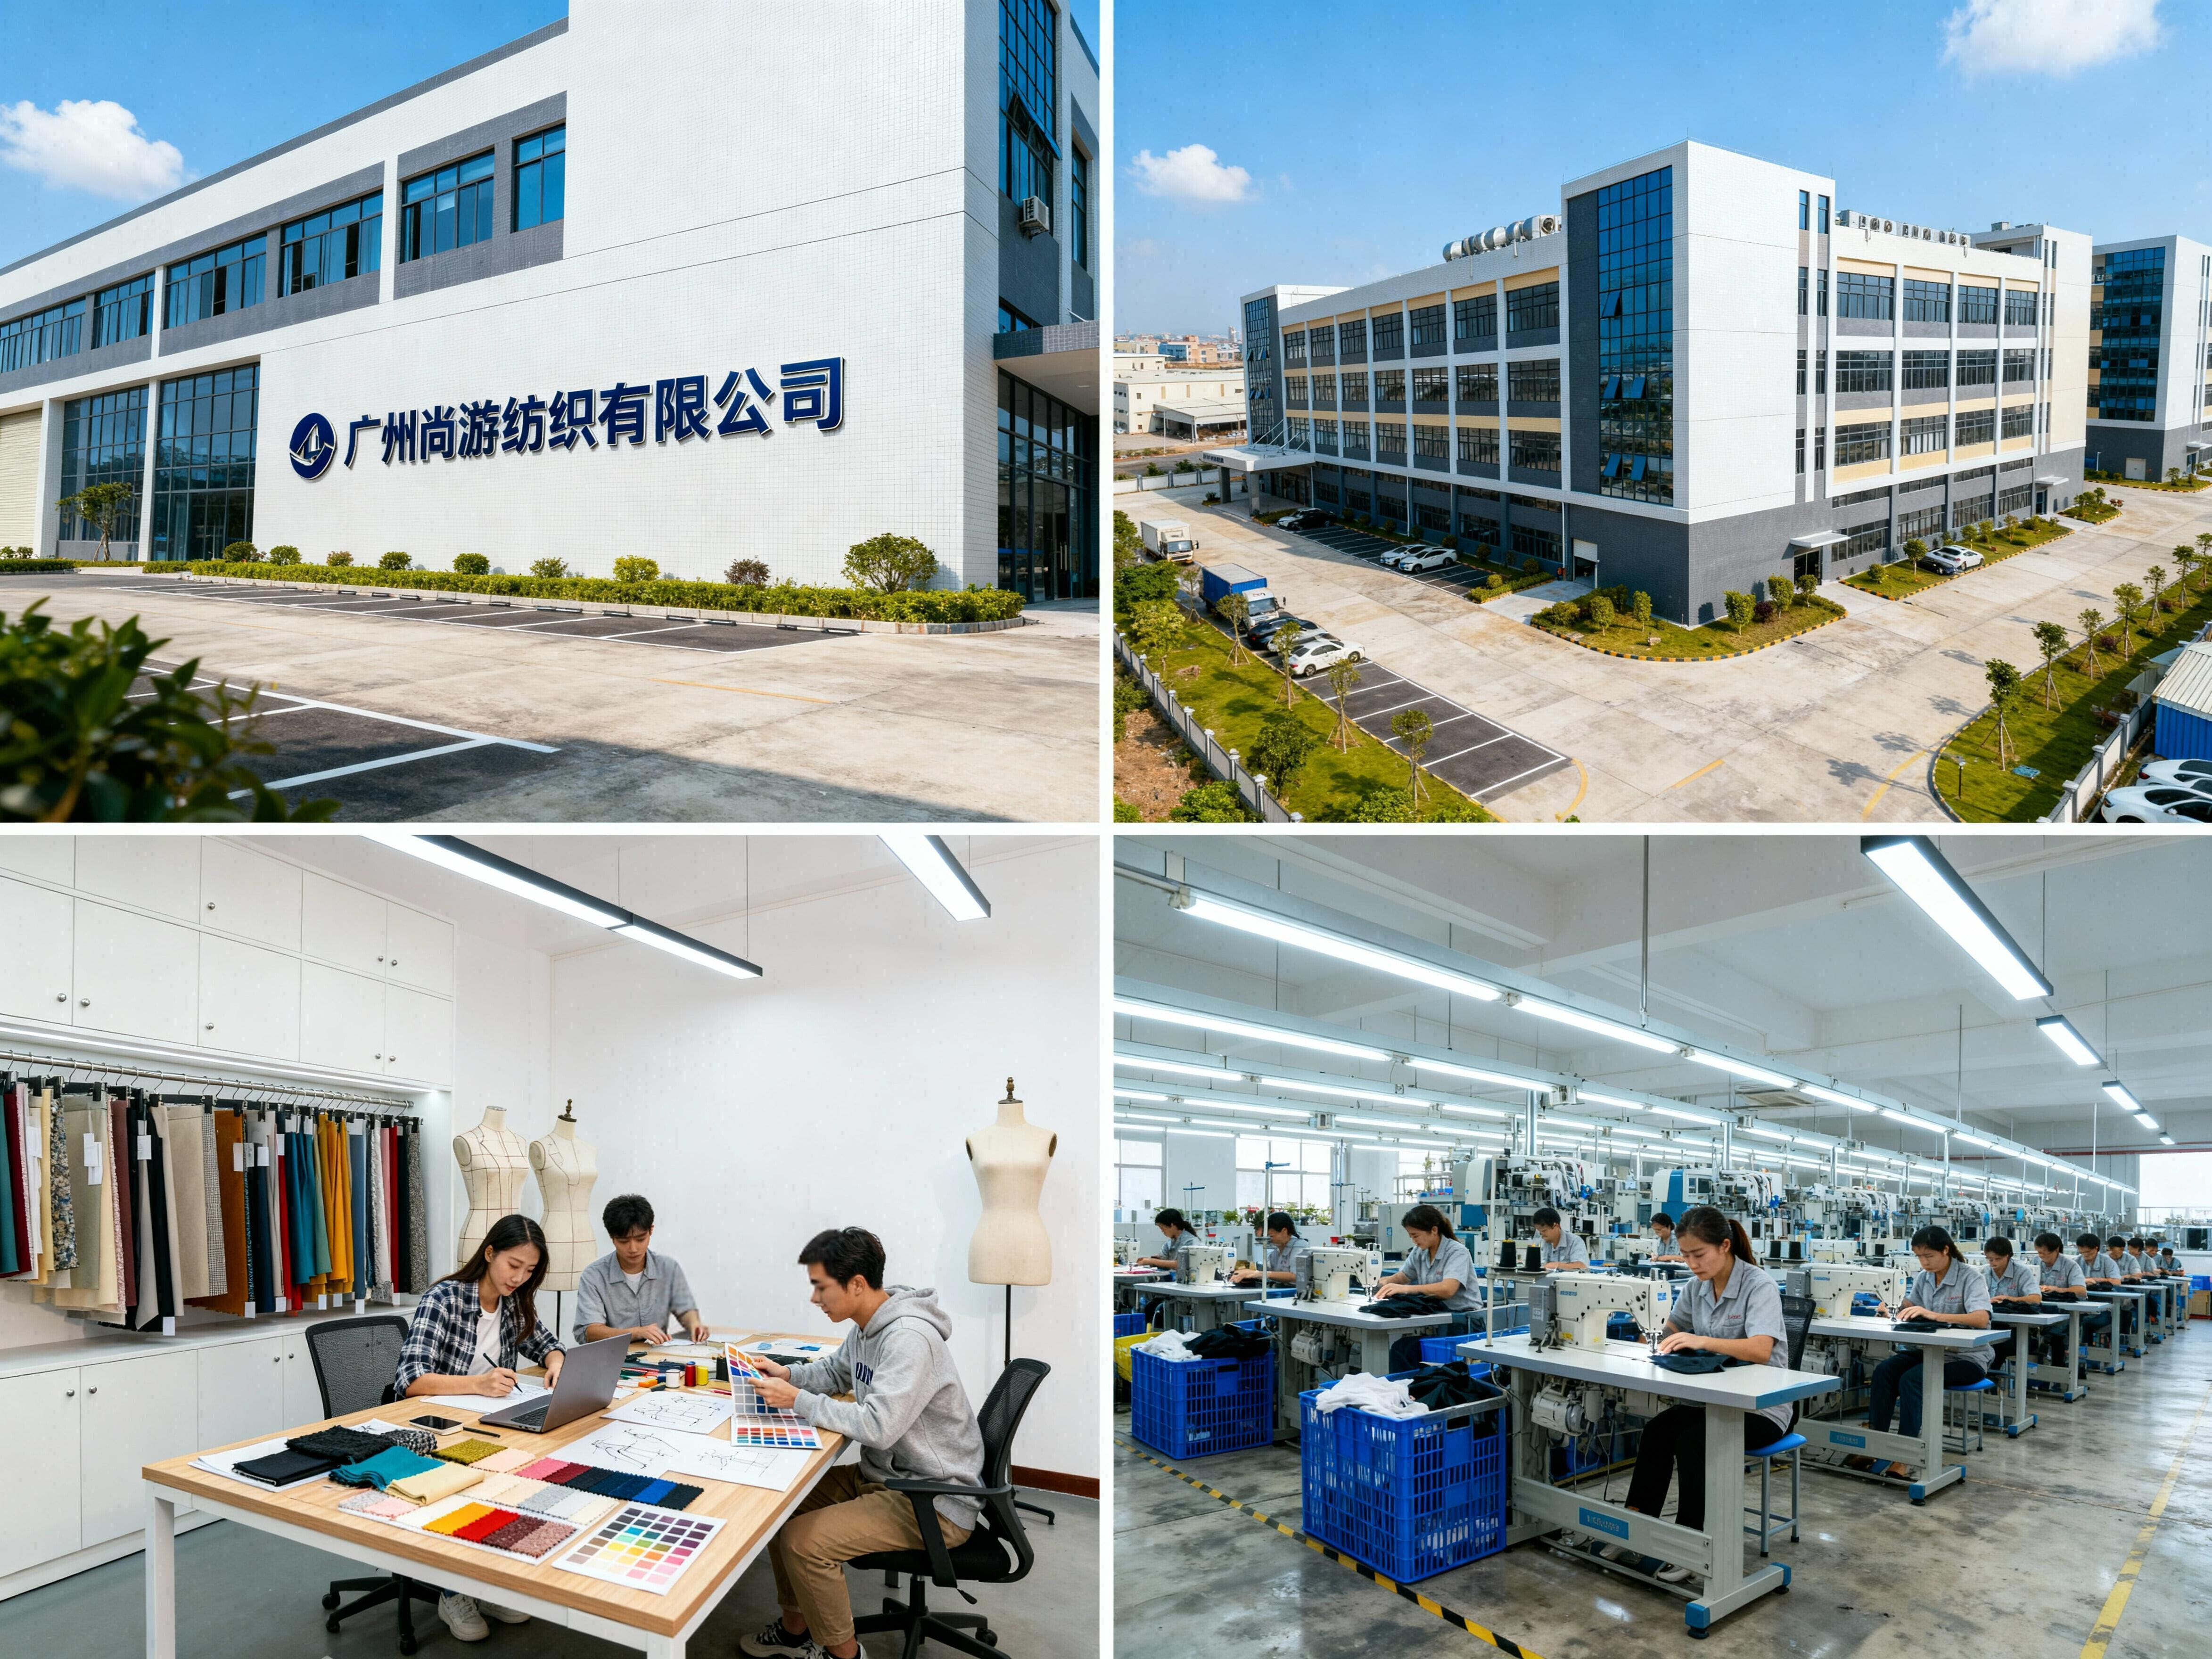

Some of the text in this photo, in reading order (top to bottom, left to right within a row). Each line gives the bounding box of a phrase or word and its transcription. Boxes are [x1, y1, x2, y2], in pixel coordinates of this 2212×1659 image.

[344, 356, 844, 468] 广州尚游纺织有限公司
